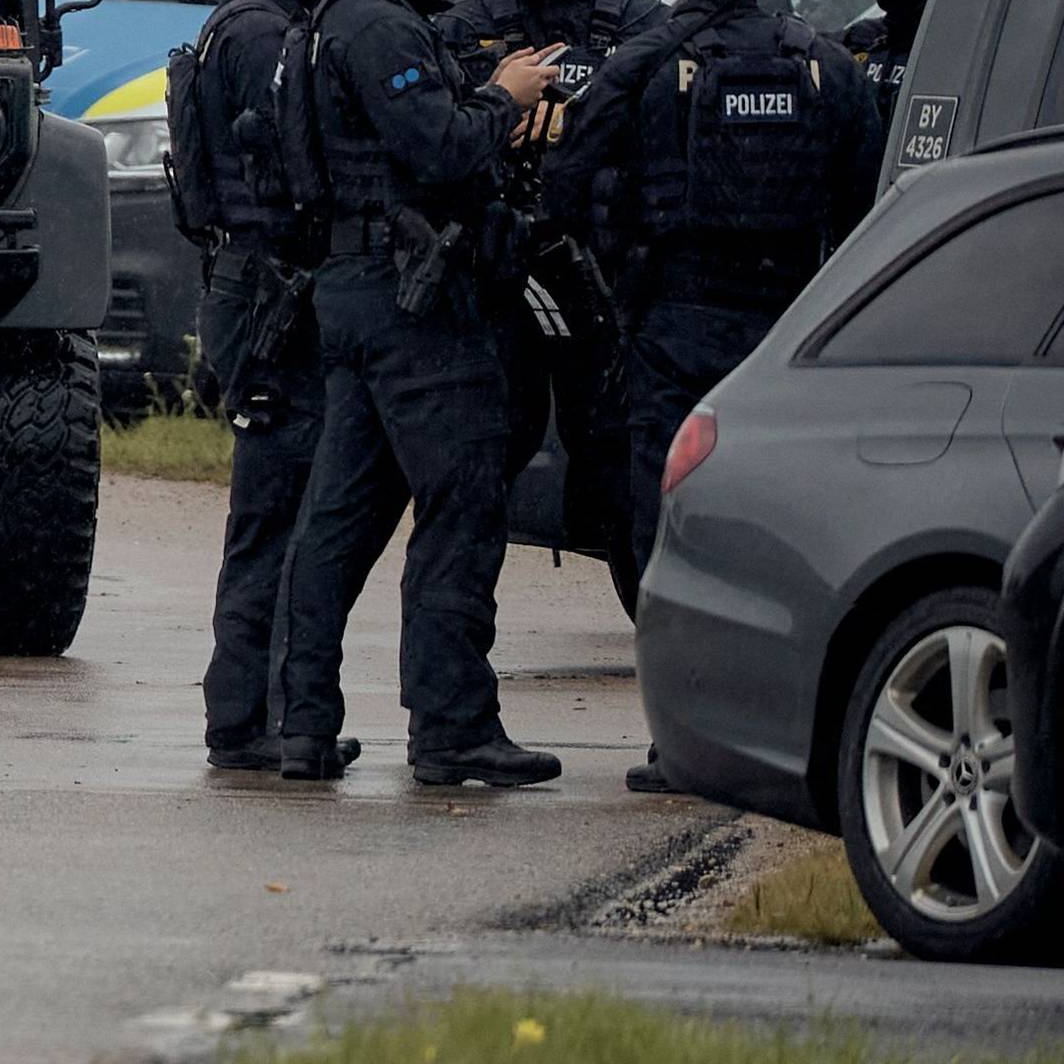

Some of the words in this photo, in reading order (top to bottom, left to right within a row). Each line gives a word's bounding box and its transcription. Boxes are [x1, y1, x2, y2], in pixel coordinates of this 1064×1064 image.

[725, 93, 792, 116] POLIZEI
[918, 104, 943, 128] BY
[905, 135, 944, 159] 4326
